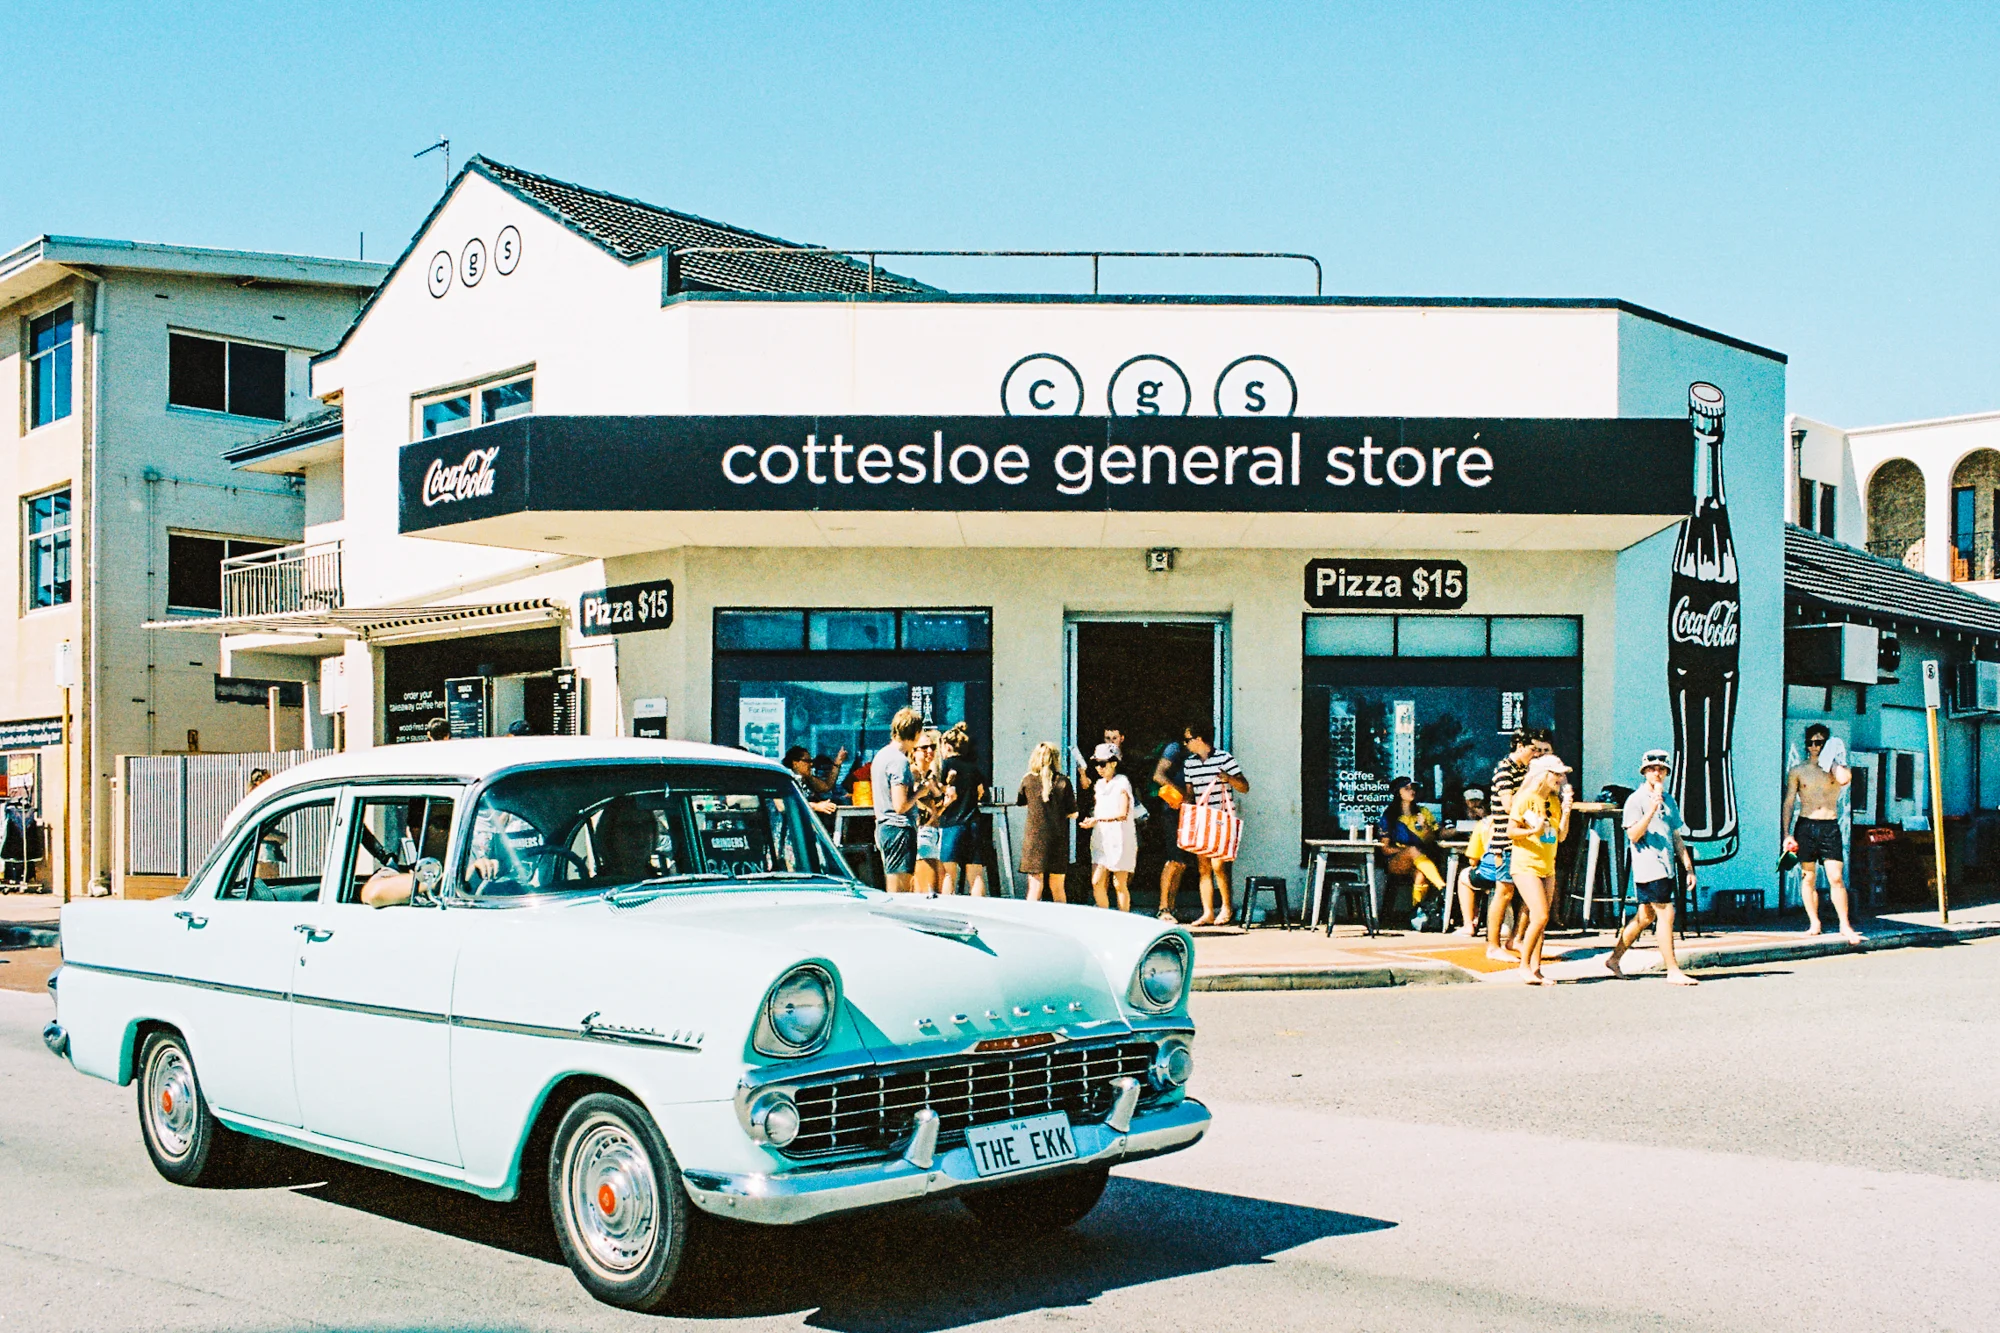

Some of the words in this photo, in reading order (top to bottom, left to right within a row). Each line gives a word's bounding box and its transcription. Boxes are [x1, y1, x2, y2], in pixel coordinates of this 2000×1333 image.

[422, 445, 500, 506] Coca-Cola
[721, 430, 1030, 484] cottesloe
[1054, 432, 1300, 495] general
[1315, 567, 1402, 598] Pizza
[1411, 566, 1462, 600] $15
[584, 597, 634, 627] Pizza
[638, 589, 668, 623] $15
[1672, 595, 1739, 647] Coca-Cola
[1339, 770, 1375, 780] Coffee
[1339, 792, 1355, 802] Ice
[1011, 1123, 1027, 1132] WA
[976, 1136, 1020, 1171] THE
[1029, 1126, 1073, 1161] EKK
